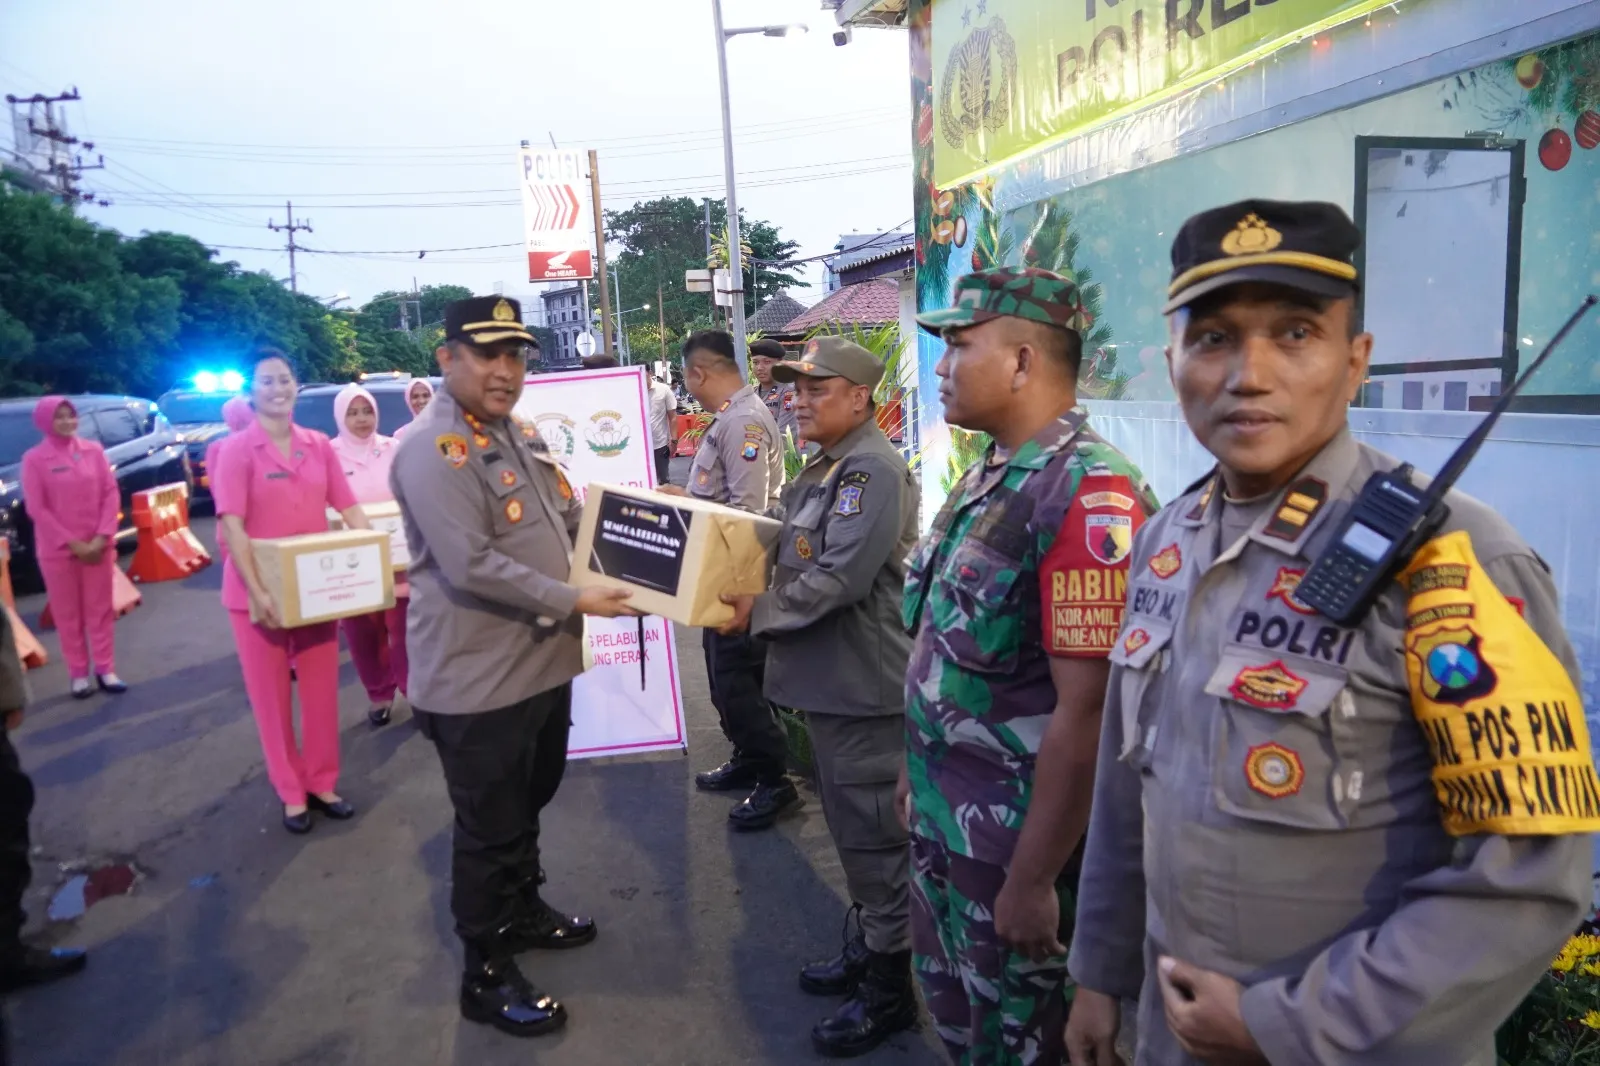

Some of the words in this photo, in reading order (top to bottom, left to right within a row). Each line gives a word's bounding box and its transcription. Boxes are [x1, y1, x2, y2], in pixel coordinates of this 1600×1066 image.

[523, 154, 580, 180] POLISI
[596, 628, 659, 648] PELABUAN
[1235, 610, 1357, 665] POLRI
[614, 648, 651, 665] PERAK
[1465, 704, 1521, 761] POS
